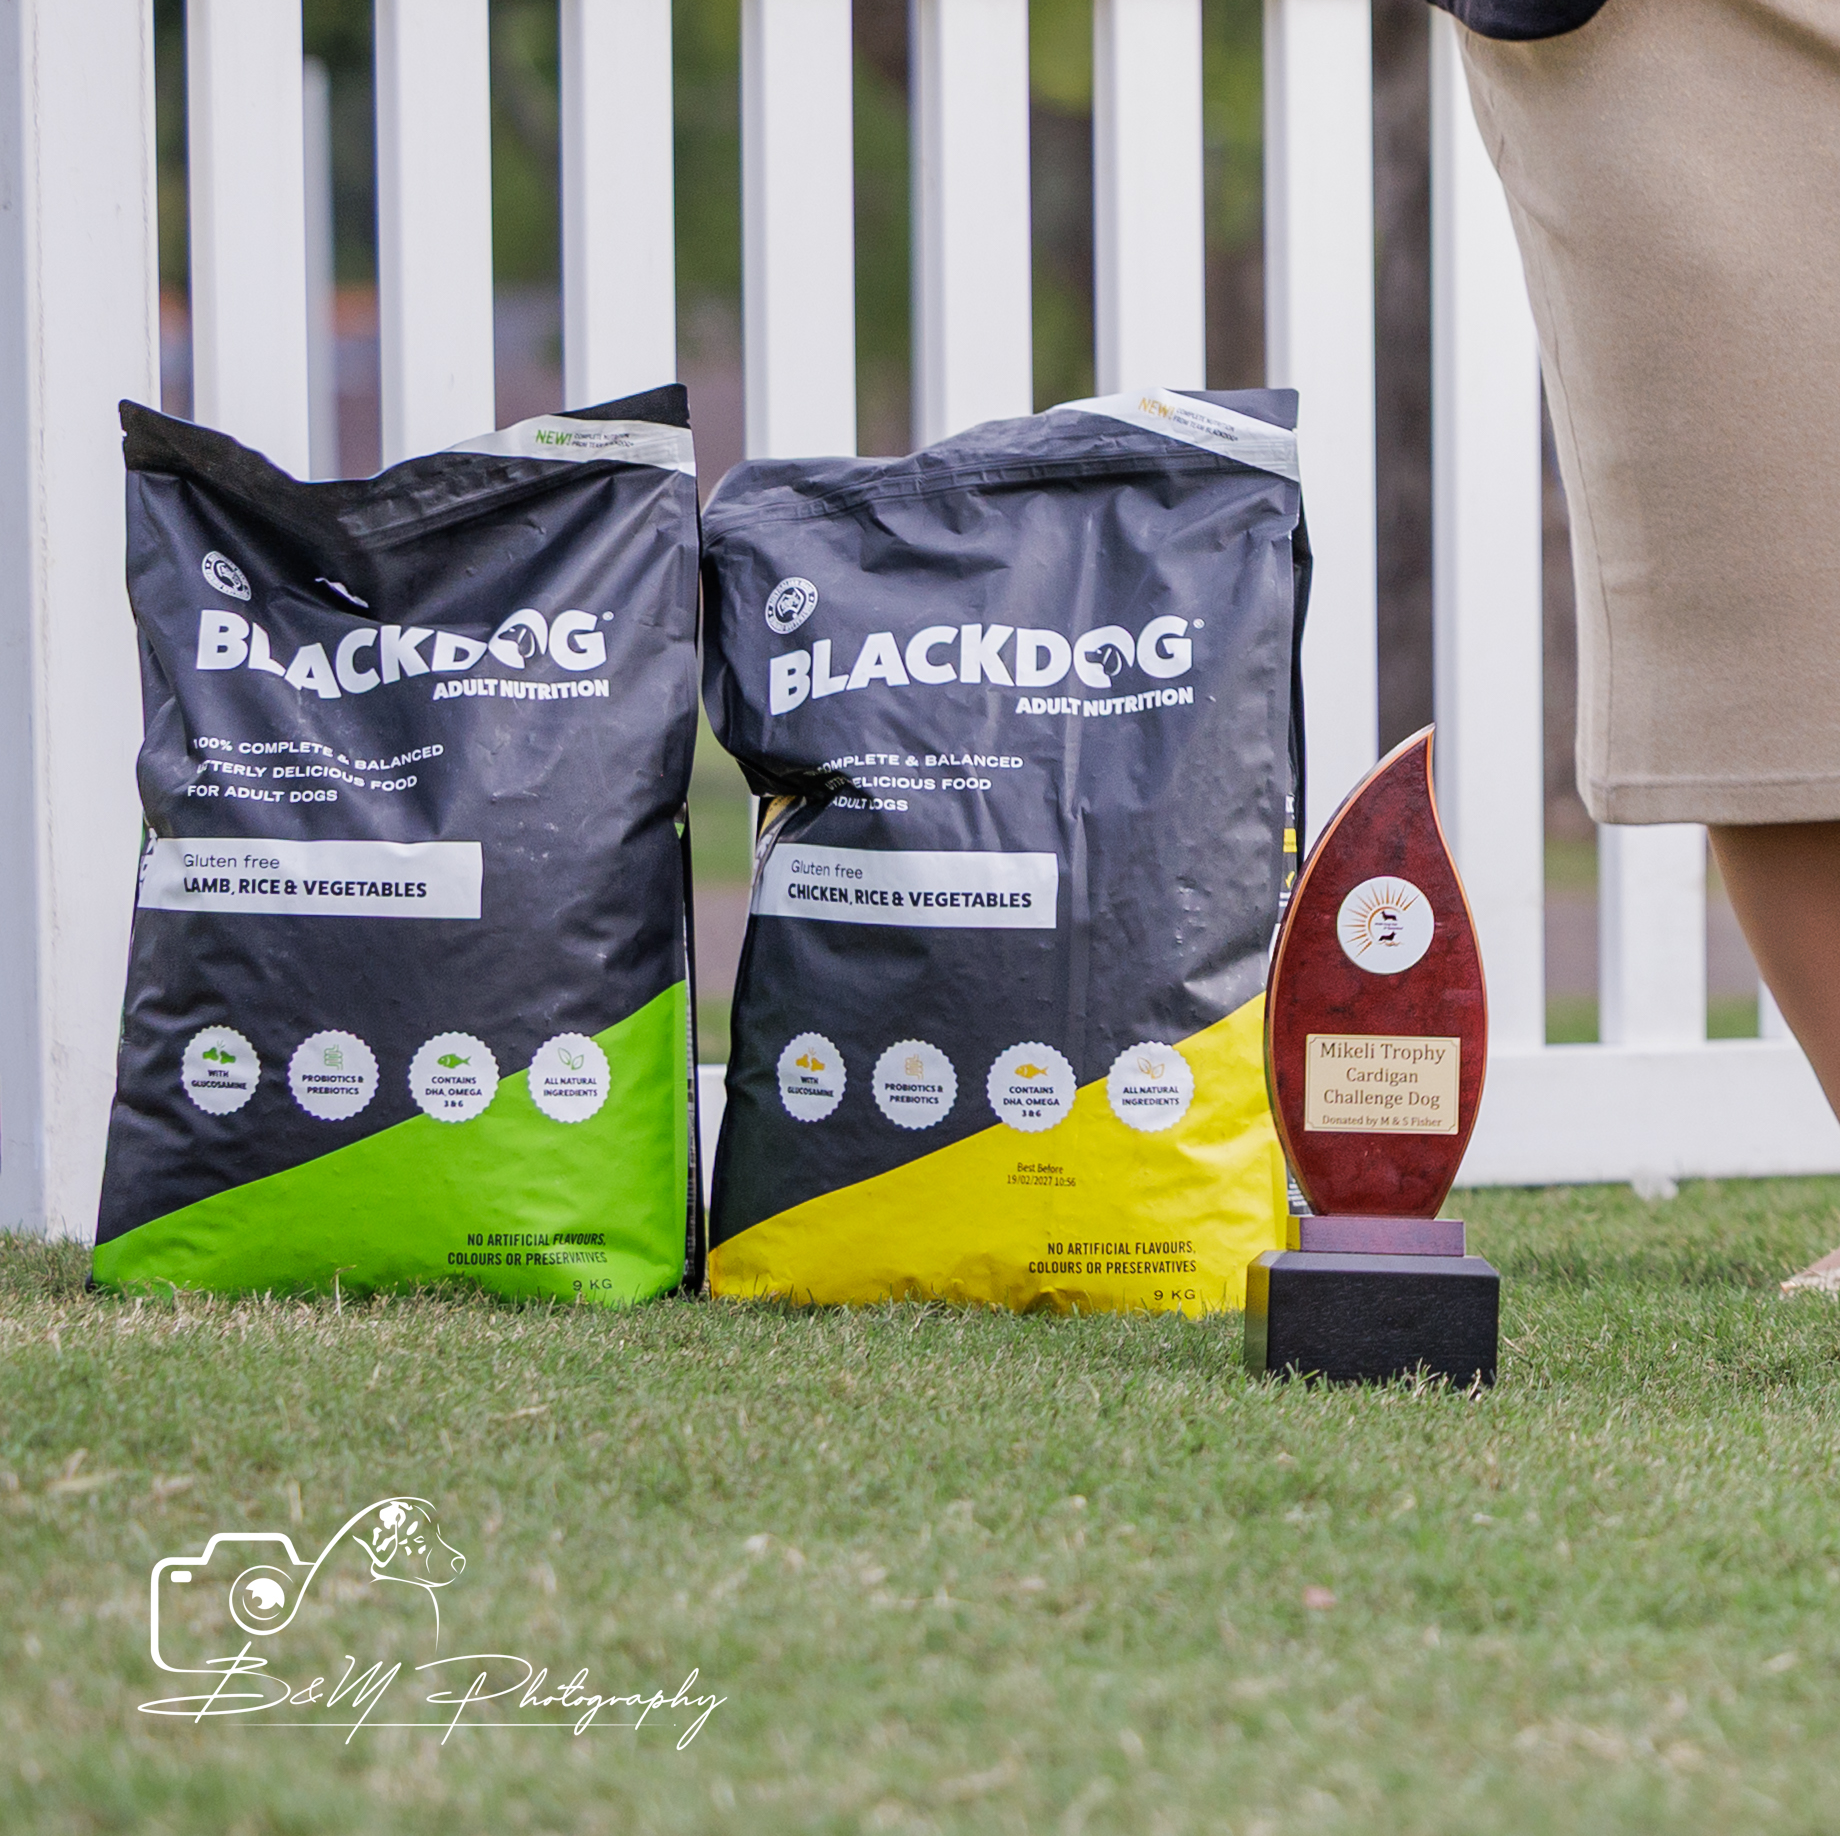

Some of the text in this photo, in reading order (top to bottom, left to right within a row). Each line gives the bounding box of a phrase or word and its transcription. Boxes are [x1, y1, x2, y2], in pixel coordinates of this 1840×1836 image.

[1138, 397, 1175, 420] NEW!
[1176, 407, 1205, 422] COMPLETE
[1173, 415, 1188, 426] FROM
[1190, 420, 1205, 431] TEAM
[535, 429, 573, 446] NEW!
[433, 678, 610, 700] ADULT NUTRITION
[1015, 686, 1194, 717] ADULT NUTRITION
[238, 741, 334, 758] COMPLETE
[337, 754, 350, 766] &
[354, 744, 444, 771] BALANCED
[817, 753, 900, 773] OMPLETE
[905, 755, 919, 767] &
[925, 754, 1024, 768] BALANCED
[272, 765, 365, 787] DELICIOUS
[370, 775, 418, 792] FOOD
[851, 776, 936, 790] ELICIOUS
[942, 777, 992, 791] FOOD
[187, 784, 338, 803] FOR ADULT DOGS
[183, 853, 280, 869] Gluten free
[791, 859, 863, 879] Gluten free
[183, 877, 427, 898] LAMB, RICE & VEGETABLES
[788, 883, 1032, 908] CHICKEN, RICE & VEGETABLES
[1320, 1042, 1446, 1065] Mikeli Trophy
[207, 1069, 229, 1078] WITH
[302, 1074, 364, 1083] PROBIOTICS &
[800, 1075, 819, 1084] WITH
[1346, 1067, 1418, 1087] Cardigan
[191, 1080, 247, 1090] GLUCOSAMINE
[431, 1076, 477, 1085] CONTAINS
[544, 1077, 597, 1085] ALL NATURAL
[307, 1086, 359, 1095] PREBIOTICS
[448, 1088, 482, 1096] OMEGA
[543, 1089, 598, 1097] INGREDIENTS
[787, 1086, 834, 1097] GLUCOSAMINE
[885, 1083, 943, 1093] PROBIOTICS &
[1009, 1086, 1054, 1095] CONTAINS
[1123, 1086, 1179, 1094] ALL NATURAL
[444, 1100, 464, 1108] 3 & 6
[890, 1095, 939, 1104] PREBIOTICS
[1025, 1098, 1060, 1106] OMEGA
[1122, 1098, 1180, 1106] INGREDIENTS
[1324, 1089, 1440, 1110] Challenge Dog
[1021, 1110, 1042, 1118] 3 & 6
[1322, 1115, 1443, 1127] Donated by M & S Fisher
[1017, 1162, 1064, 1174] Best Before
[1007, 1174, 1076, 1187] 19/02/2027 10:56
[467, 1233, 606, 1246] NO ARTIFICIAL FLAVOURS,
[1048, 1241, 1196, 1255] NO ARTIFICIAL FLAVOURS,
[448, 1251, 607, 1266] COLOURS OR PRESERVATIVES
[1029, 1260, 1197, 1274] COLOURS OR PRESERVATIVES
[572, 1278, 613, 1291] 9 KG
[1153, 1289, 1196, 1301] 9 KG
